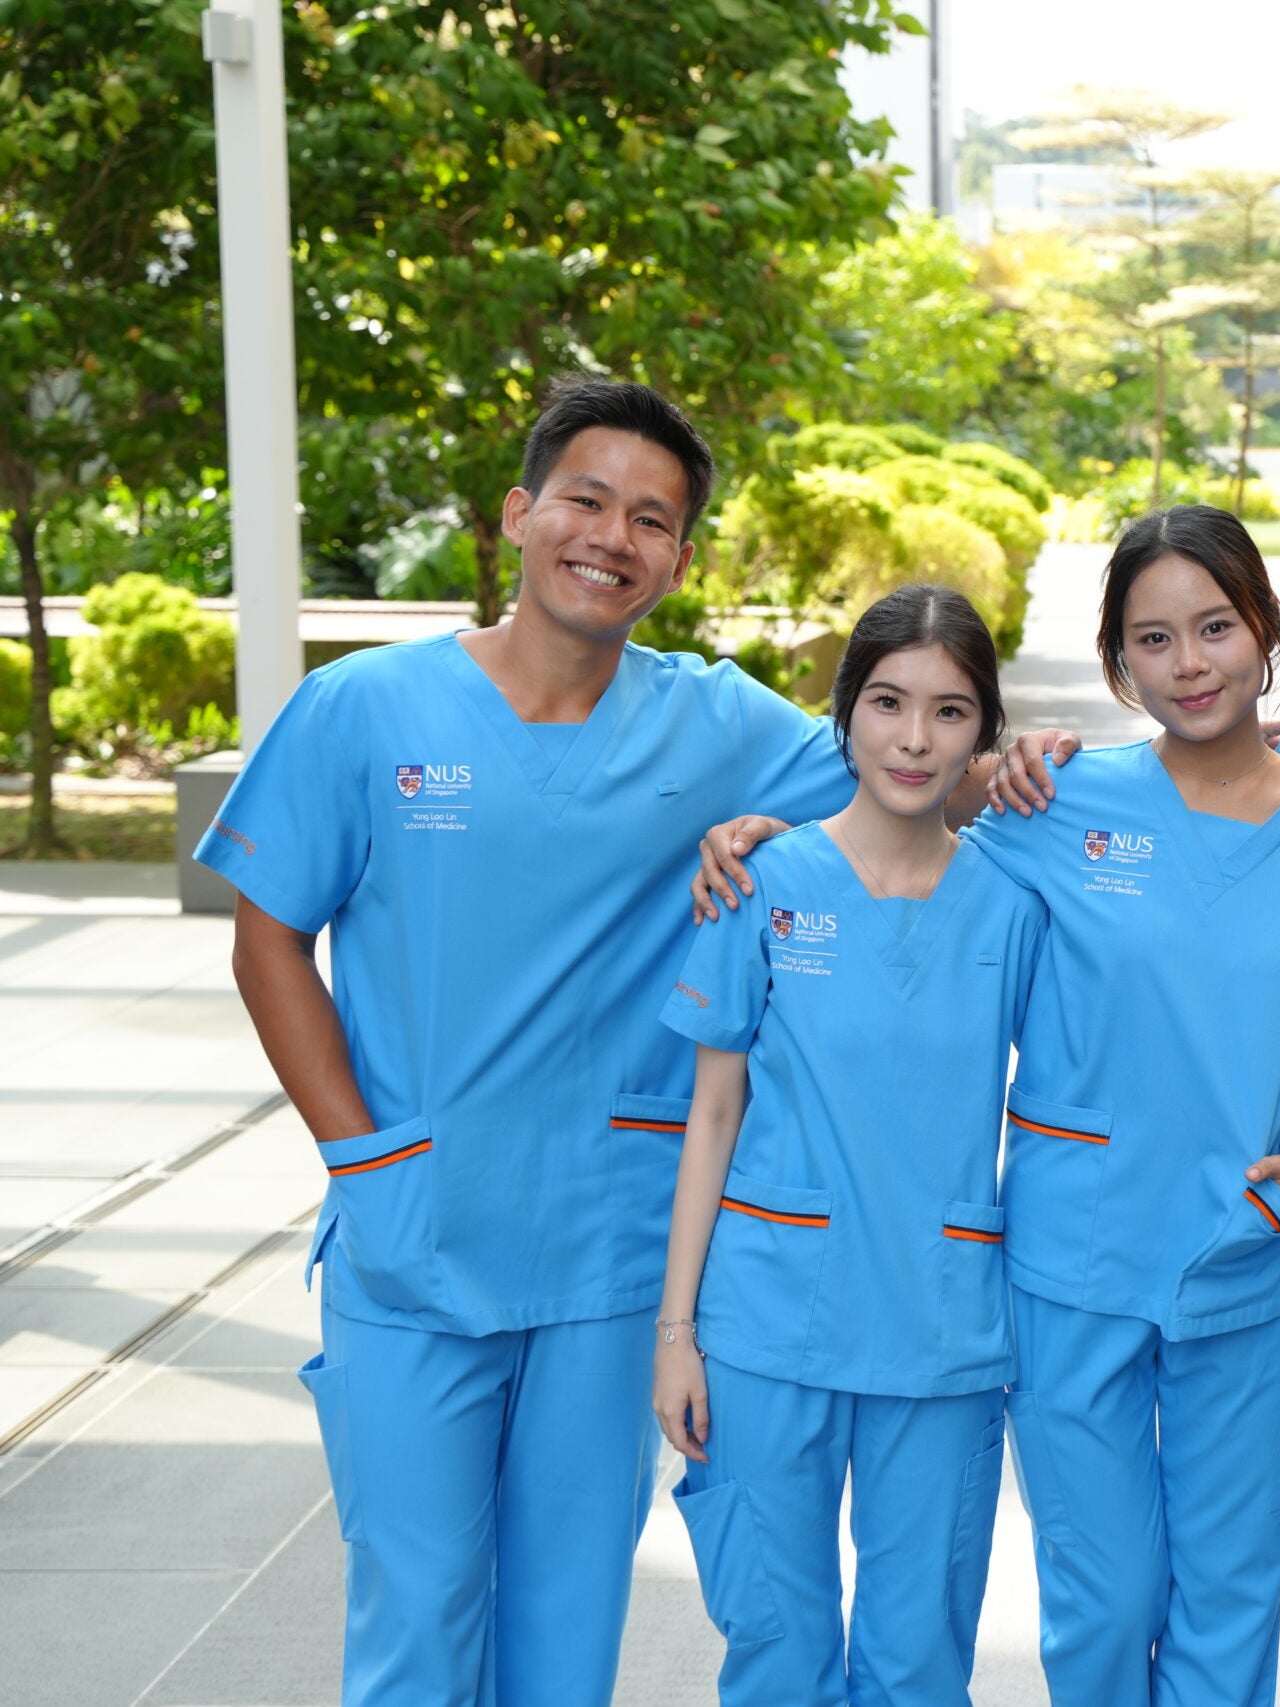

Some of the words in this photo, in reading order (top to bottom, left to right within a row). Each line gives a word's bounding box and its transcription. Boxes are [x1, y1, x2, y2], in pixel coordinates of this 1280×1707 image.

[425, 764, 472, 783] NUS
[412, 813, 429, 822] Yong
[446, 813, 457, 821] Lin
[403, 822, 426, 830] School
[427, 822, 435, 830] of
[435, 822, 468, 831] Medicine
[1111, 832, 1154, 853] NUS
[1094, 875, 1110, 884] Yong
[1111, 877, 1124, 885] Loo
[1084, 883, 1104, 891] School
[1113, 886, 1143, 896] Medicine
[795, 911, 837, 931] NUS
[783, 953, 797, 965] Yong
[772, 962, 792, 971] School
[793, 965, 801, 973] of
[802, 966, 832, 976] Medicine
